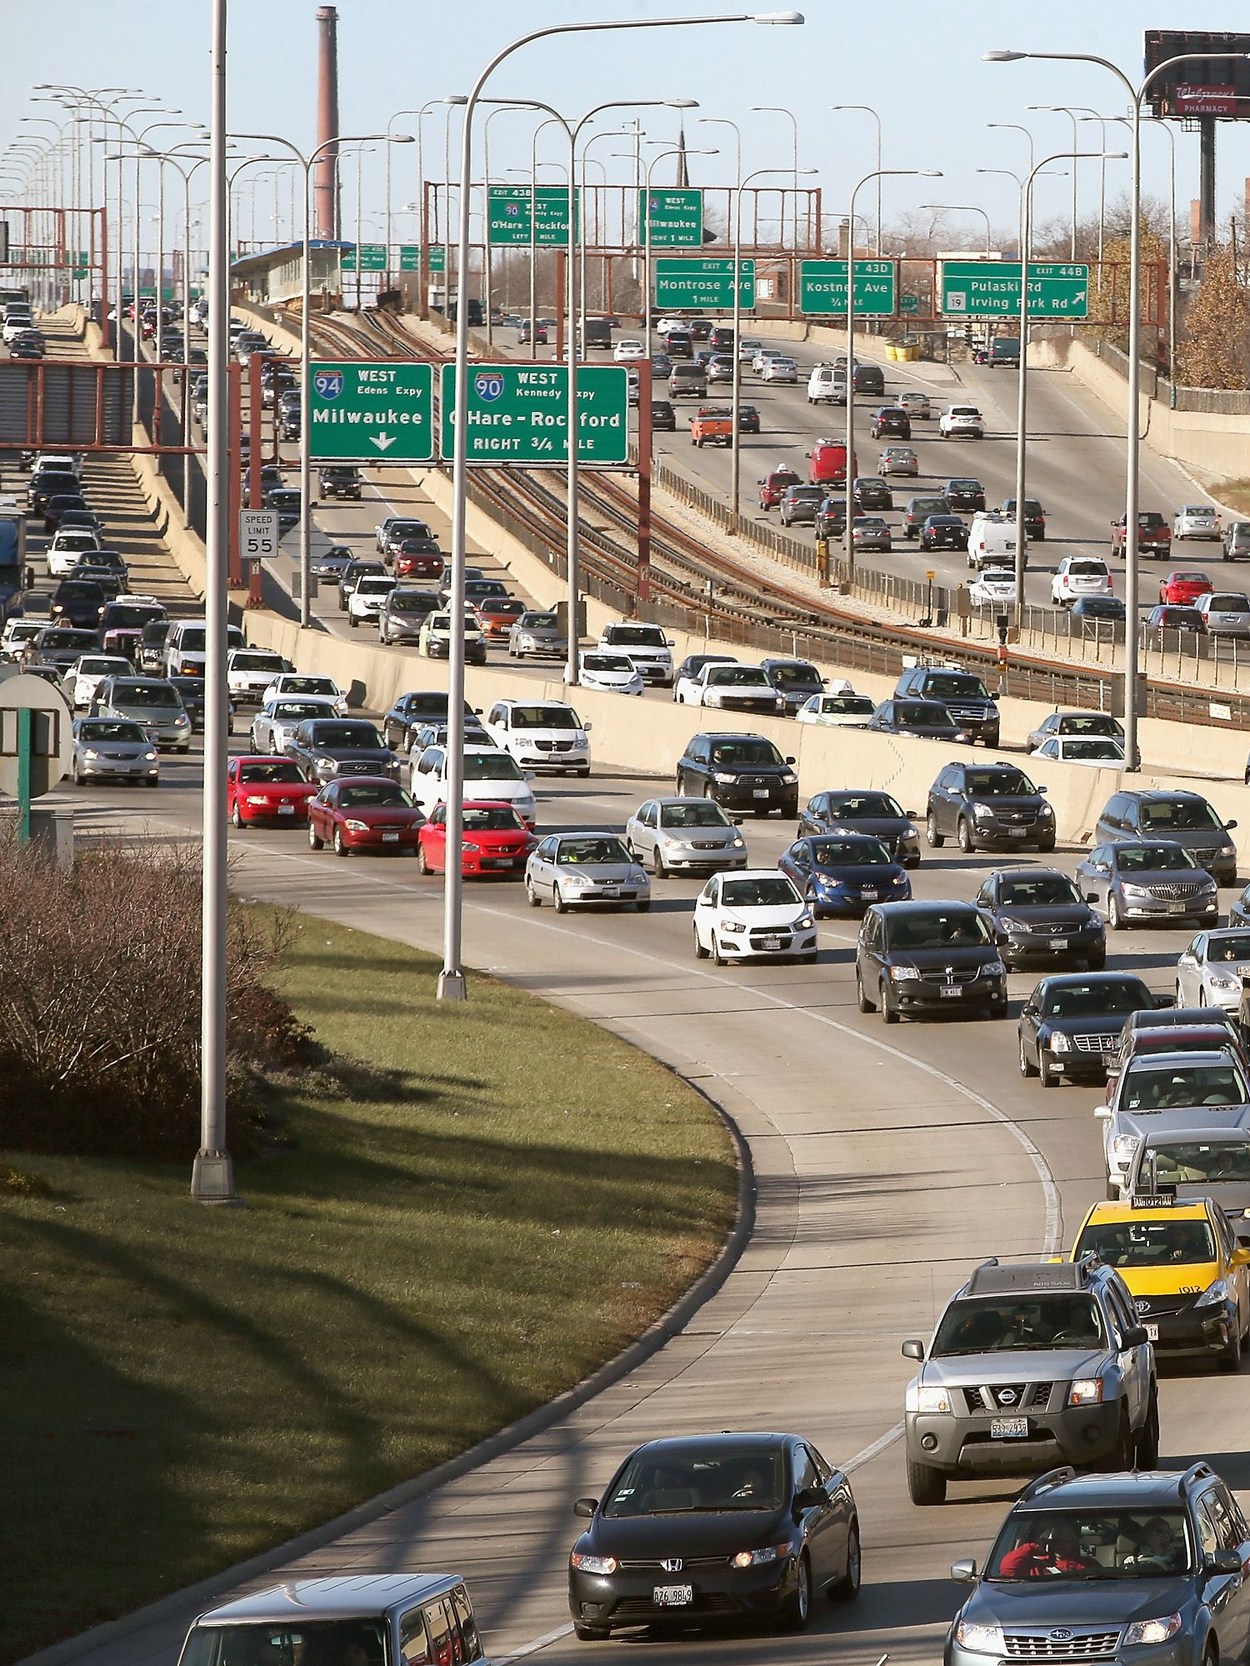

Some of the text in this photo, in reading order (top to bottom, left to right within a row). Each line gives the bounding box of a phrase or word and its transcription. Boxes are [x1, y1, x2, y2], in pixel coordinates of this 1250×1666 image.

[491, 220, 523, 229] O'Hare
[702, 261, 749, 271] EXIT 4C
[865, 263, 888, 273] 43D
[1036, 267, 1083, 276] EXIT 44B
[660, 280, 721, 290] Montrose
[864, 283, 888, 293] Ave
[971, 281, 1019, 292] Pulaski
[952, 298, 962, 307] 19
[971, 298, 1009, 309] Irving
[1052, 298, 1068, 309] Rd
[358, 369, 397, 382] WEST
[517, 372, 558, 385] WEST
[316, 377, 340, 394] 94
[477, 380, 501, 396] 90
[357, 386, 423, 398] Edens Expy
[516, 388, 595, 401] Kennedy xpy
[313, 408, 422, 425] Milwaukee
[531, 411, 621, 428] Rocford
[473, 437, 521, 450] RIGHT
[245, 515, 273, 524] SPEED
[247, 527, 270, 535] LIMIT
[247, 538, 272, 553] 55
[1178, 1285, 1202, 1295] 1012
[673, 1589, 692, 1601] 9849
